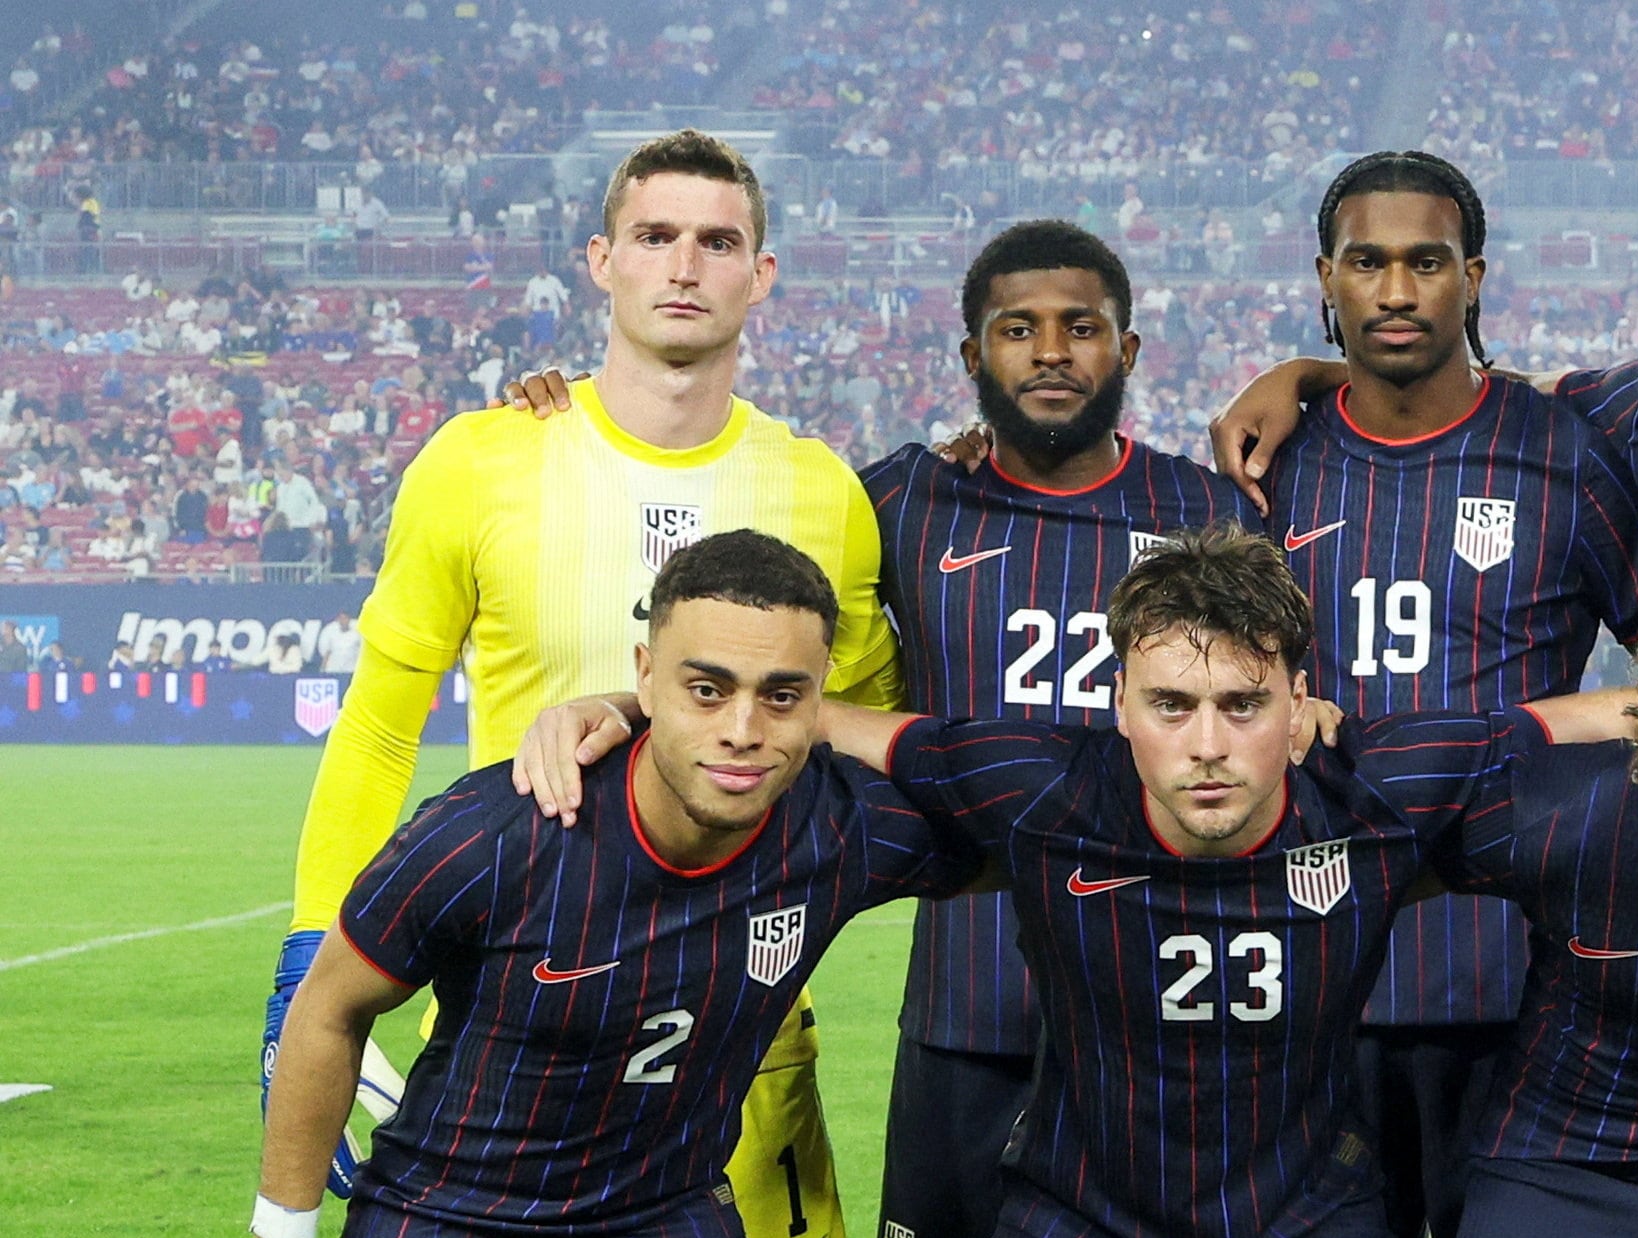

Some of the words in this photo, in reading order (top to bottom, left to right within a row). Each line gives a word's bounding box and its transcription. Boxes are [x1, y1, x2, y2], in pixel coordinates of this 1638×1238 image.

[1004, 608, 1115, 710] 22
[1351, 577, 1432, 677] 19
[300, 684, 335, 702] USA
[1290, 843, 1344, 868] USA
[754, 911, 802, 944] USA
[1159, 932, 1283, 1021] 23
[623, 1009, 695, 1084] 2
[777, 1144, 808, 1238] 1
